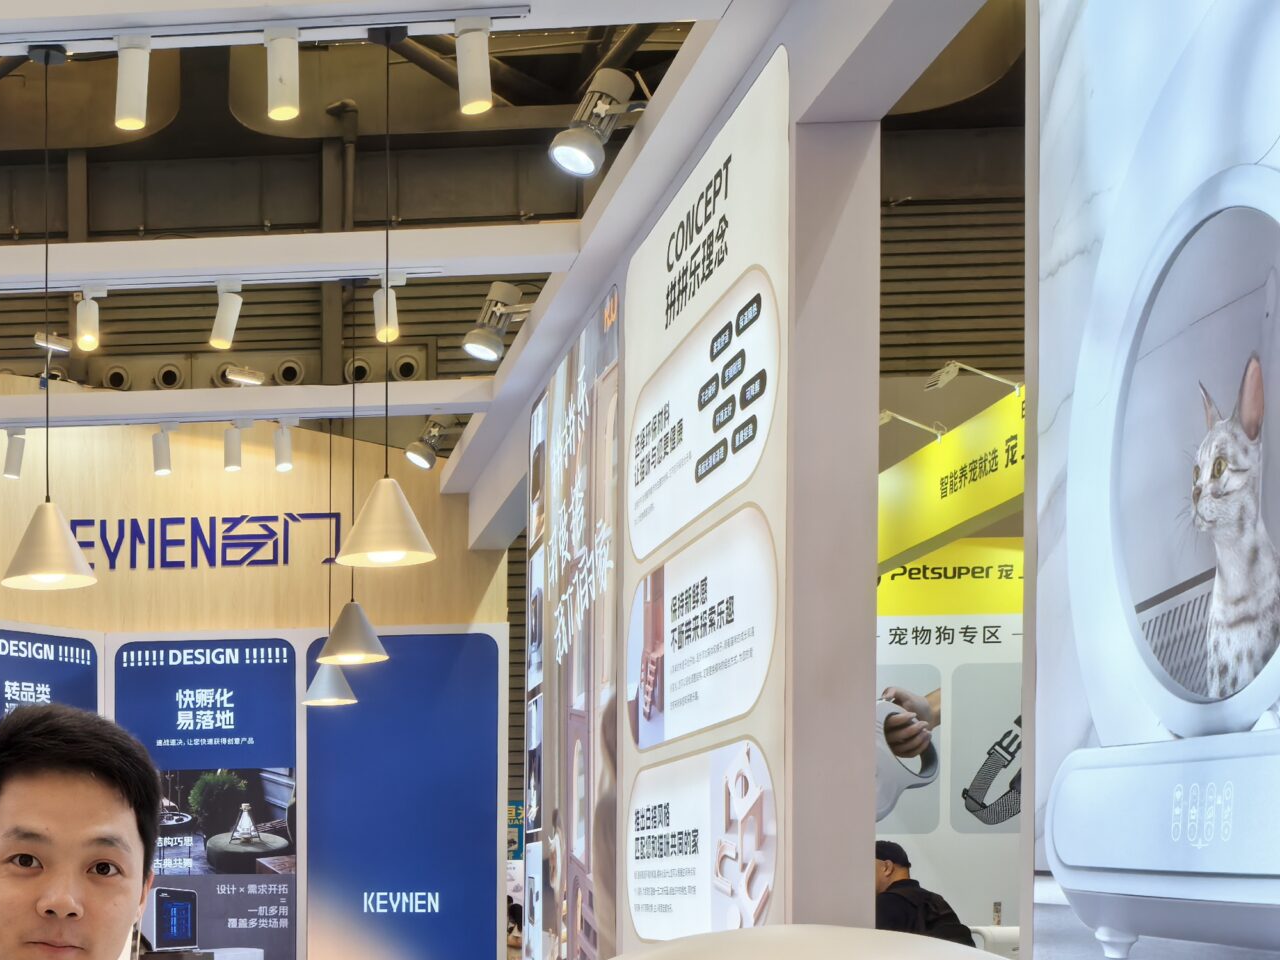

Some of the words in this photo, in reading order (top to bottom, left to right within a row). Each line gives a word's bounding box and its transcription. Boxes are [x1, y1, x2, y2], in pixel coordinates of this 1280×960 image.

[666, 154, 733, 273] CONCEPT
[664, 215, 729, 330] 拼拼乐理念
[940, 448, 999, 499] 智能养宠就选
[1005, 434, 1025, 468] 宠
[891, 565, 993, 580] Petsuper
[998, 564, 1024, 579] 宠
[671, 576, 708, 623] 保持新鲜感
[670, 595, 734, 653] 不断带来探索乐趣
[888, 626, 1003, 646] 宠物狗专区
[169, 648, 239, 665] DESIGN
[4, 680, 51, 703] 转品类
[176, 688, 234, 708] 快孵化
[177, 710, 234, 730] 易落地
[216, 884, 237, 895] 设计
[247, 884, 288, 895] 需求开拓
[248, 906, 288, 916] 一机多用
[228, 918, 288, 929] 覆盖多类场景
